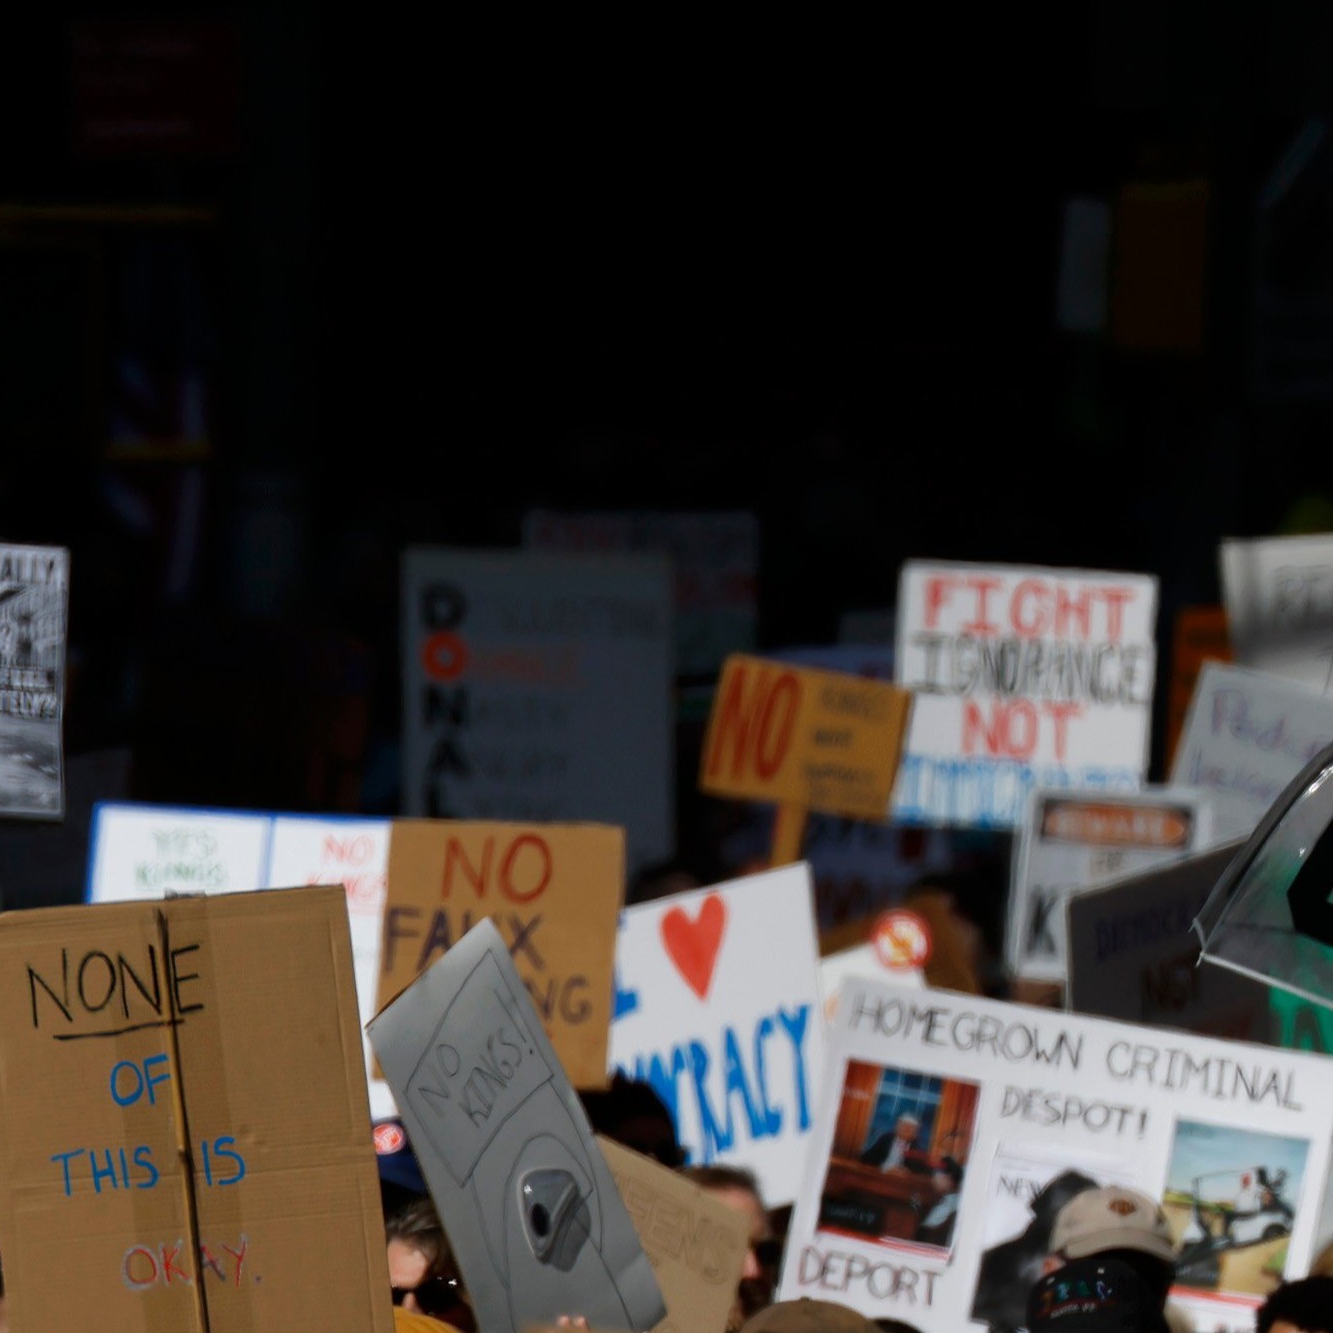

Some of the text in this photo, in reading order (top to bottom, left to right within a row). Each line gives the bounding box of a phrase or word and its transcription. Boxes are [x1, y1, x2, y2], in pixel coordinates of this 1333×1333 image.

[923, 573, 1137, 647] FIGHT
[707, 665, 802, 781] NO
[961, 696, 1086, 763] NOT
[320, 833, 377, 867] NO
[440, 832, 554, 905] NO
[383, 905, 548, 976] FAX
[25, 943, 205, 1029] NONE
[109, 1053, 171, 1106] OF
[417, 1042, 462, 1120] NO
[848, 992, 1307, 1112] HOMEGROWN CRIMINAL
[998, 1084, 1149, 1140] DESPOT!
[51, 1136, 248, 1198] THIS IS
[122, 1239, 263, 1292] OKAY.
[796, 1245, 943, 1307] DEPORT
